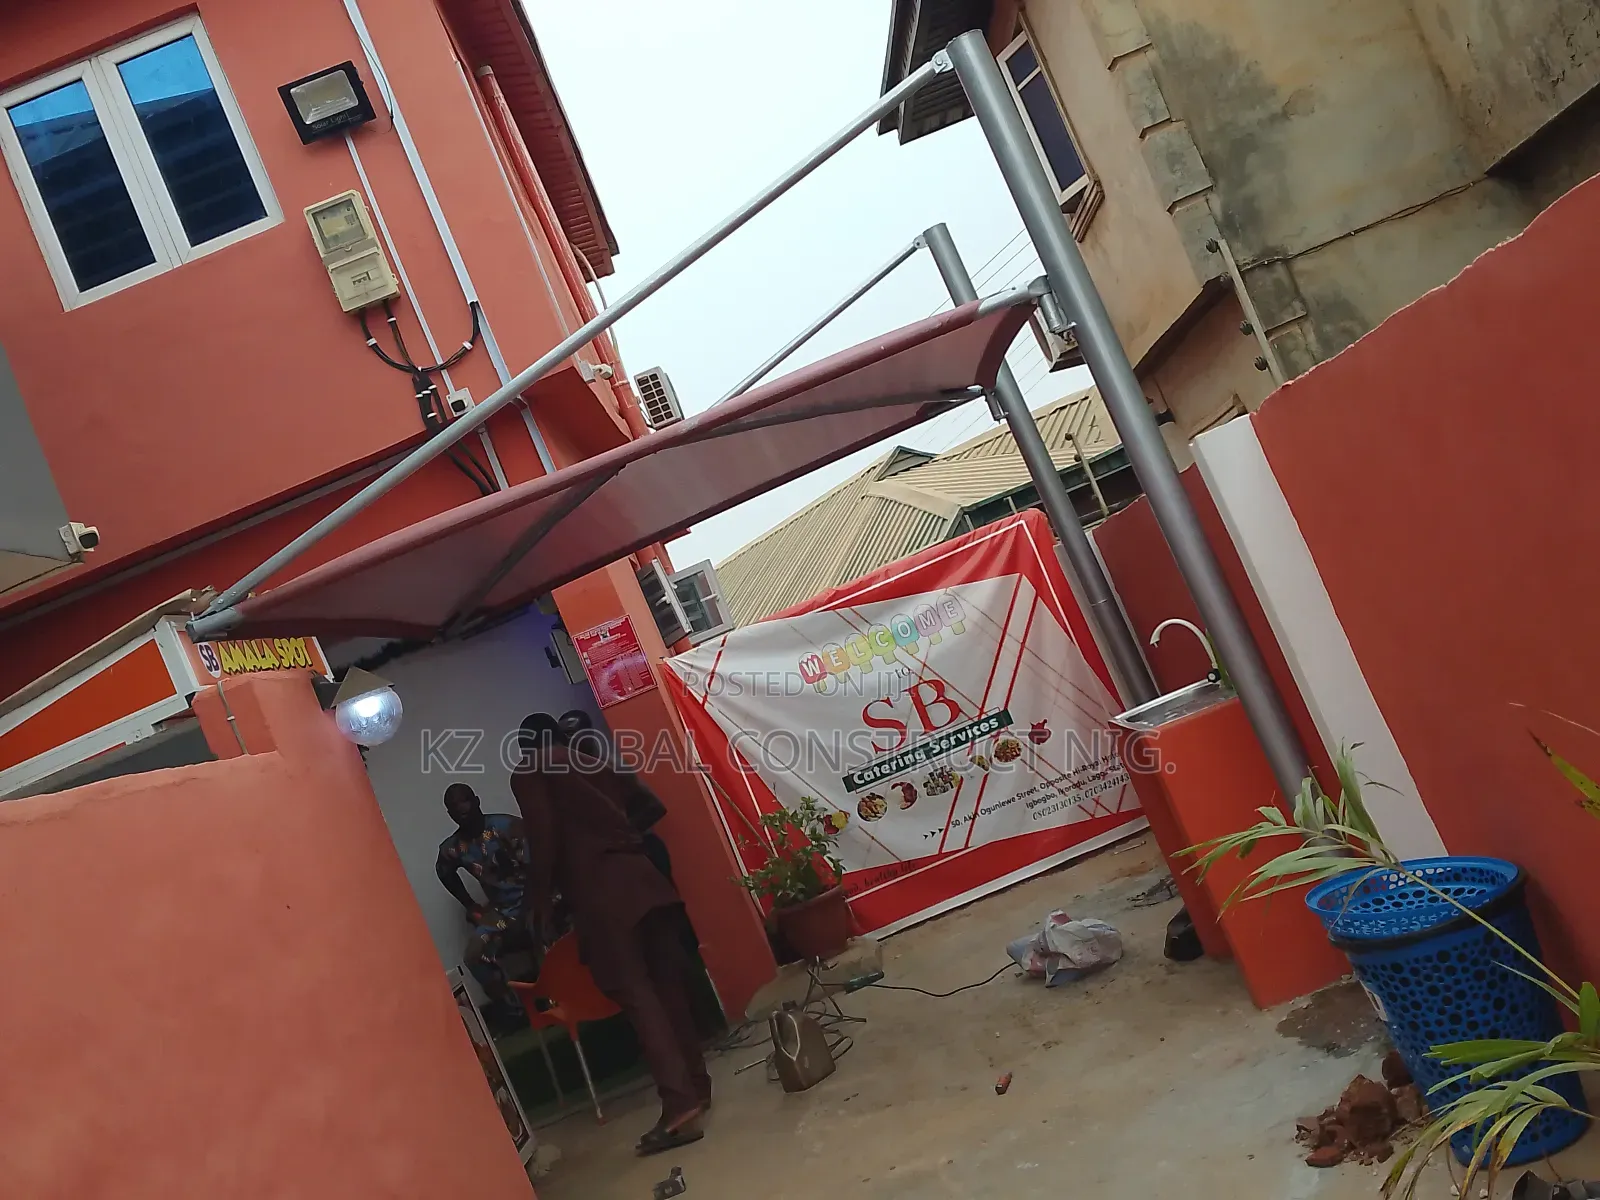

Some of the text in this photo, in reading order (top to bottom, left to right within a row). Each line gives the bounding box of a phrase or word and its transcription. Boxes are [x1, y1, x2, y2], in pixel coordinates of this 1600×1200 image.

[199, 637, 314, 675] SB AMALA SPOT
[801, 600, 959, 677] WELCOME
[862, 679, 961, 754] SB
[852, 717, 1000, 785] Catering Services
[980, 797, 1016, 816] Ogunlewe
[1016, 785, 1040, 801] Street,
[1039, 772, 1072, 791] Opposite
[1026, 792, 1058, 810] Igbogbo,
